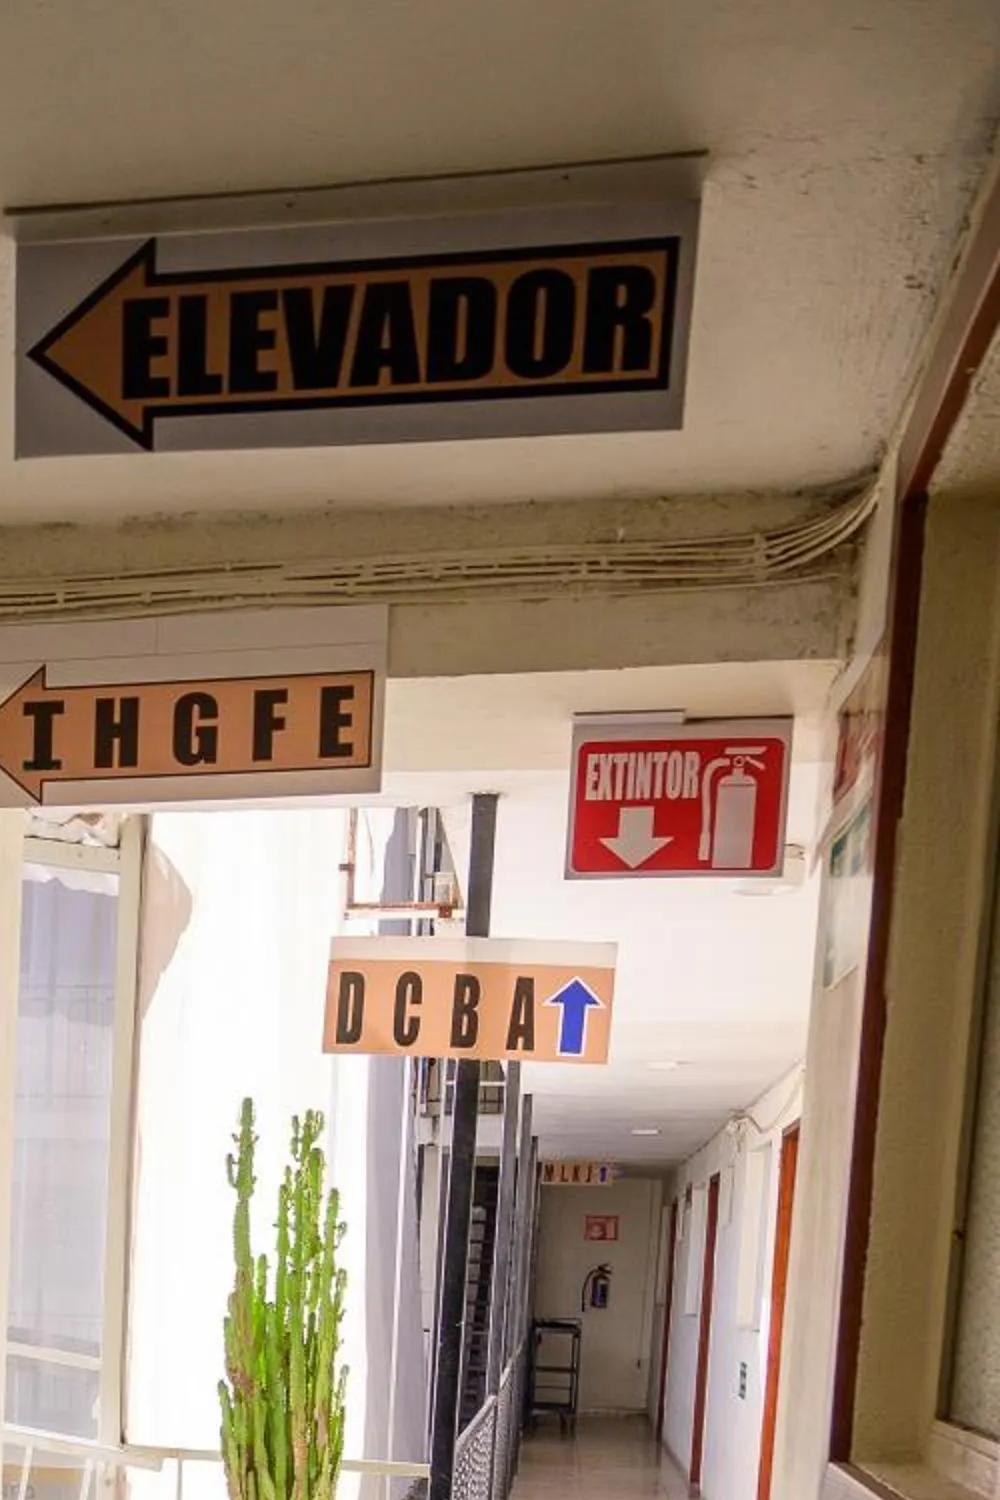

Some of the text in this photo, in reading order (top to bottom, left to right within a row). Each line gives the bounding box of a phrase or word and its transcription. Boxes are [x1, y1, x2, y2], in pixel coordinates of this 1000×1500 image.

[121, 263, 658, 400] ELEVADOR
[22, 685, 355, 771] I H G F E
[585, 750, 700, 801] EXTINTOR
[335, 971, 535, 1051] D C B A
